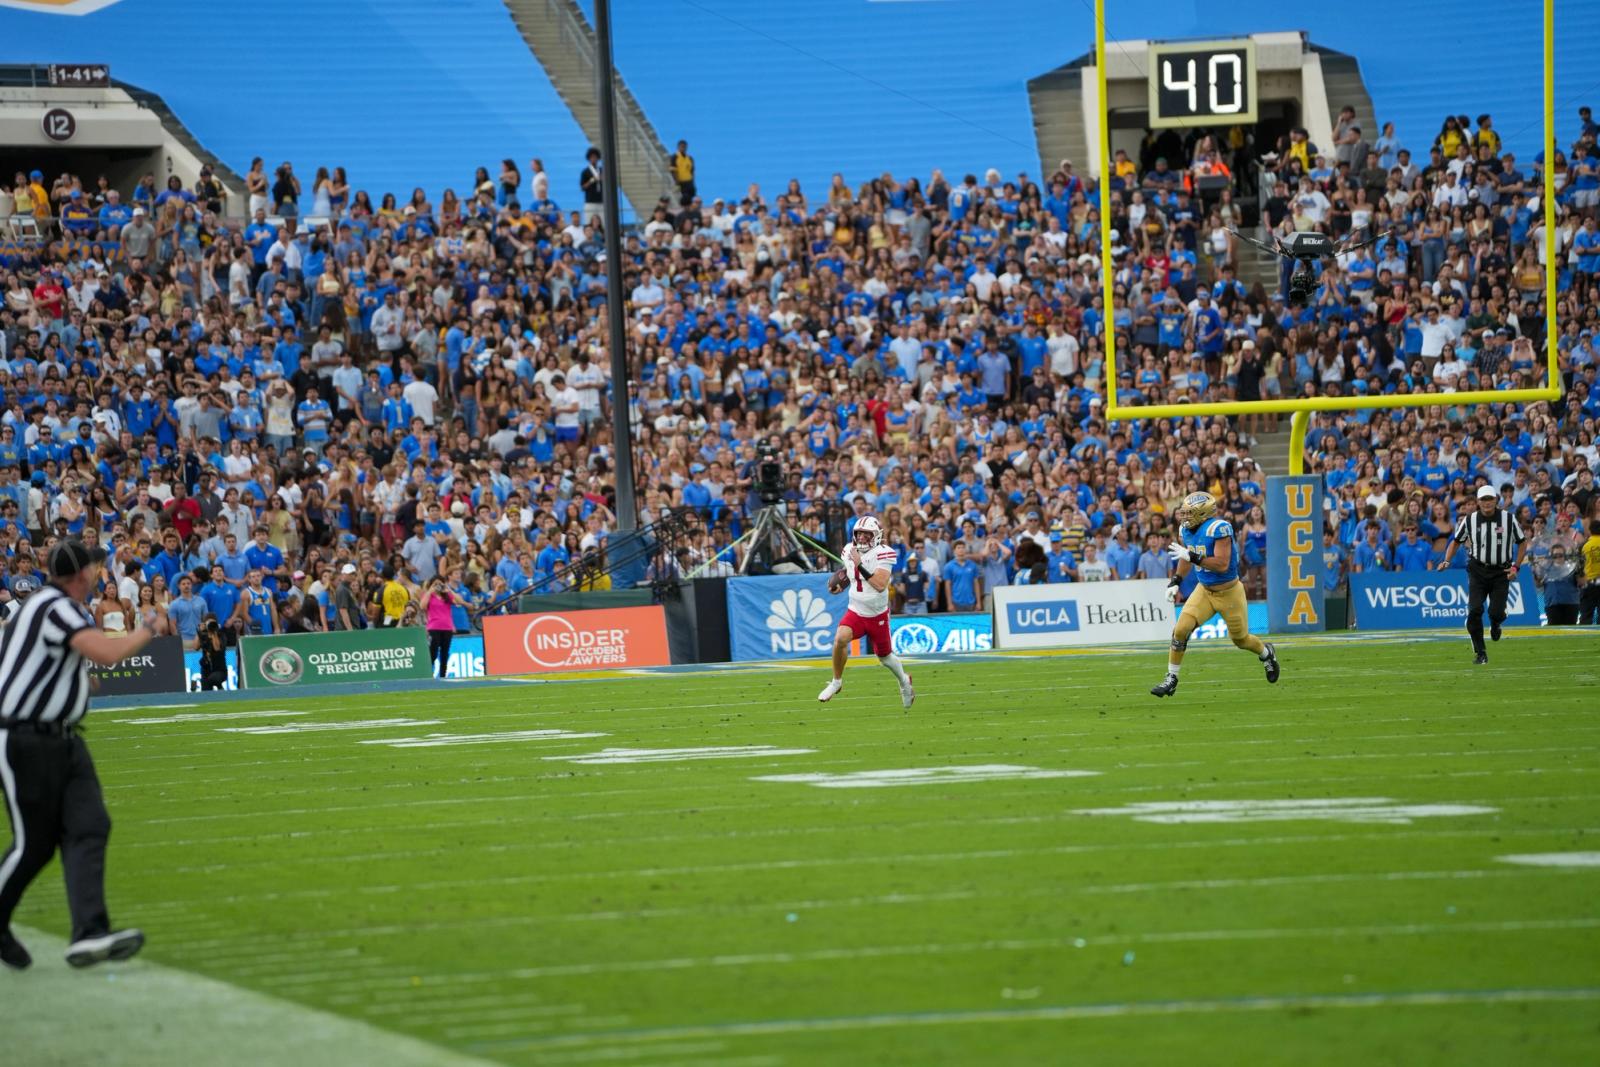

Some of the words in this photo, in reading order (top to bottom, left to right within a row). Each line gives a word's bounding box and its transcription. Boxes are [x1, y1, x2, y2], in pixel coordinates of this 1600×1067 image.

[59, 67, 92, 81] 1-41
[1163, 53, 1242, 114] 40
[49, 115, 70, 135] 12
[1285, 484, 1318, 625] UCLA
[1016, 607, 1071, 627] UCLA
[537, 629, 625, 650] INSIDER
[771, 630, 834, 654] NBC
[308, 653, 338, 665] OLD
[340, 647, 415, 662] DOMINION
[564, 654, 627, 666] LAWYERS
[570, 645, 626, 657] ACCIDENT
[317, 661, 379, 676] FREIGHT
[382, 658, 414, 671] LINE
